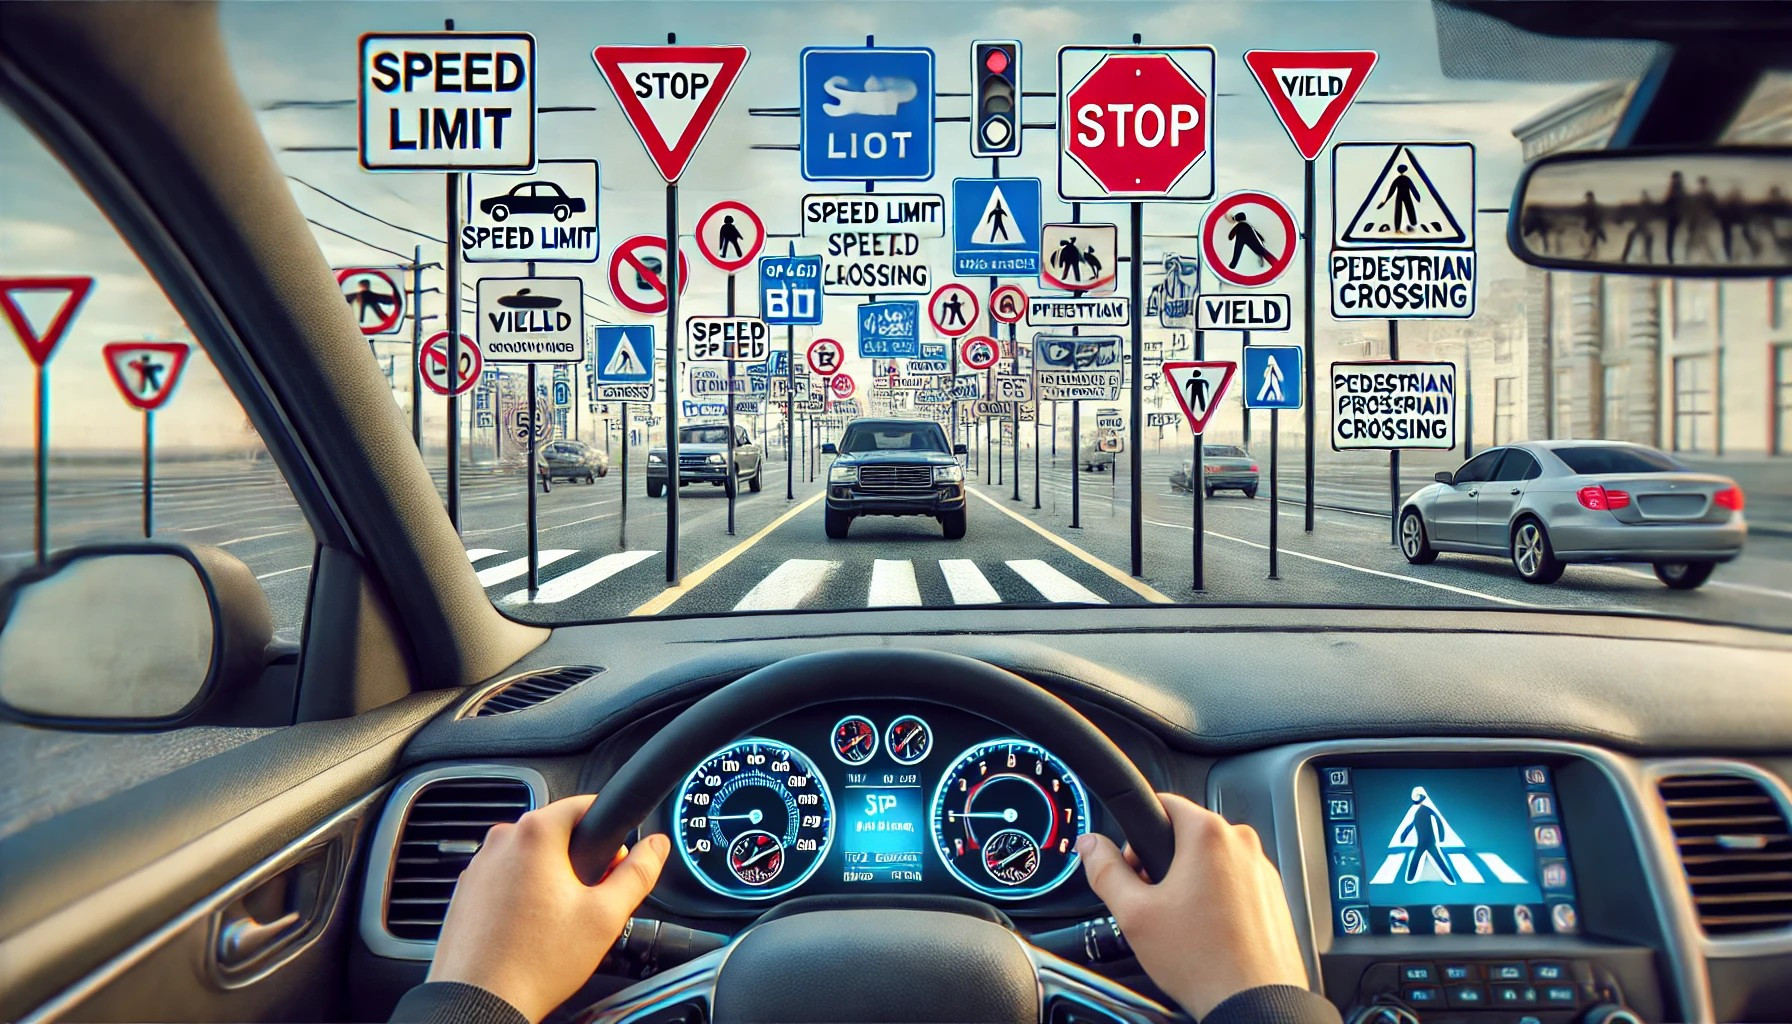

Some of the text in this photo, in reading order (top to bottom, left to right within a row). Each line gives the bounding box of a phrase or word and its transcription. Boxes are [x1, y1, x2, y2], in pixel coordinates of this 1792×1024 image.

[371, 51, 526, 93] SPEED
[635, 72, 709, 100] STOP
[389, 108, 512, 150] LIMIT
[1077, 103, 1199, 148] STOP
[827, 131, 912, 159] LIOT
[807, 201, 941, 224] SPEED LIMIT
[462, 225, 596, 250] SPEED LIMIT
[1332, 255, 1472, 281] PEDESTRIAN
[1340, 283, 1467, 309] CROSSING
